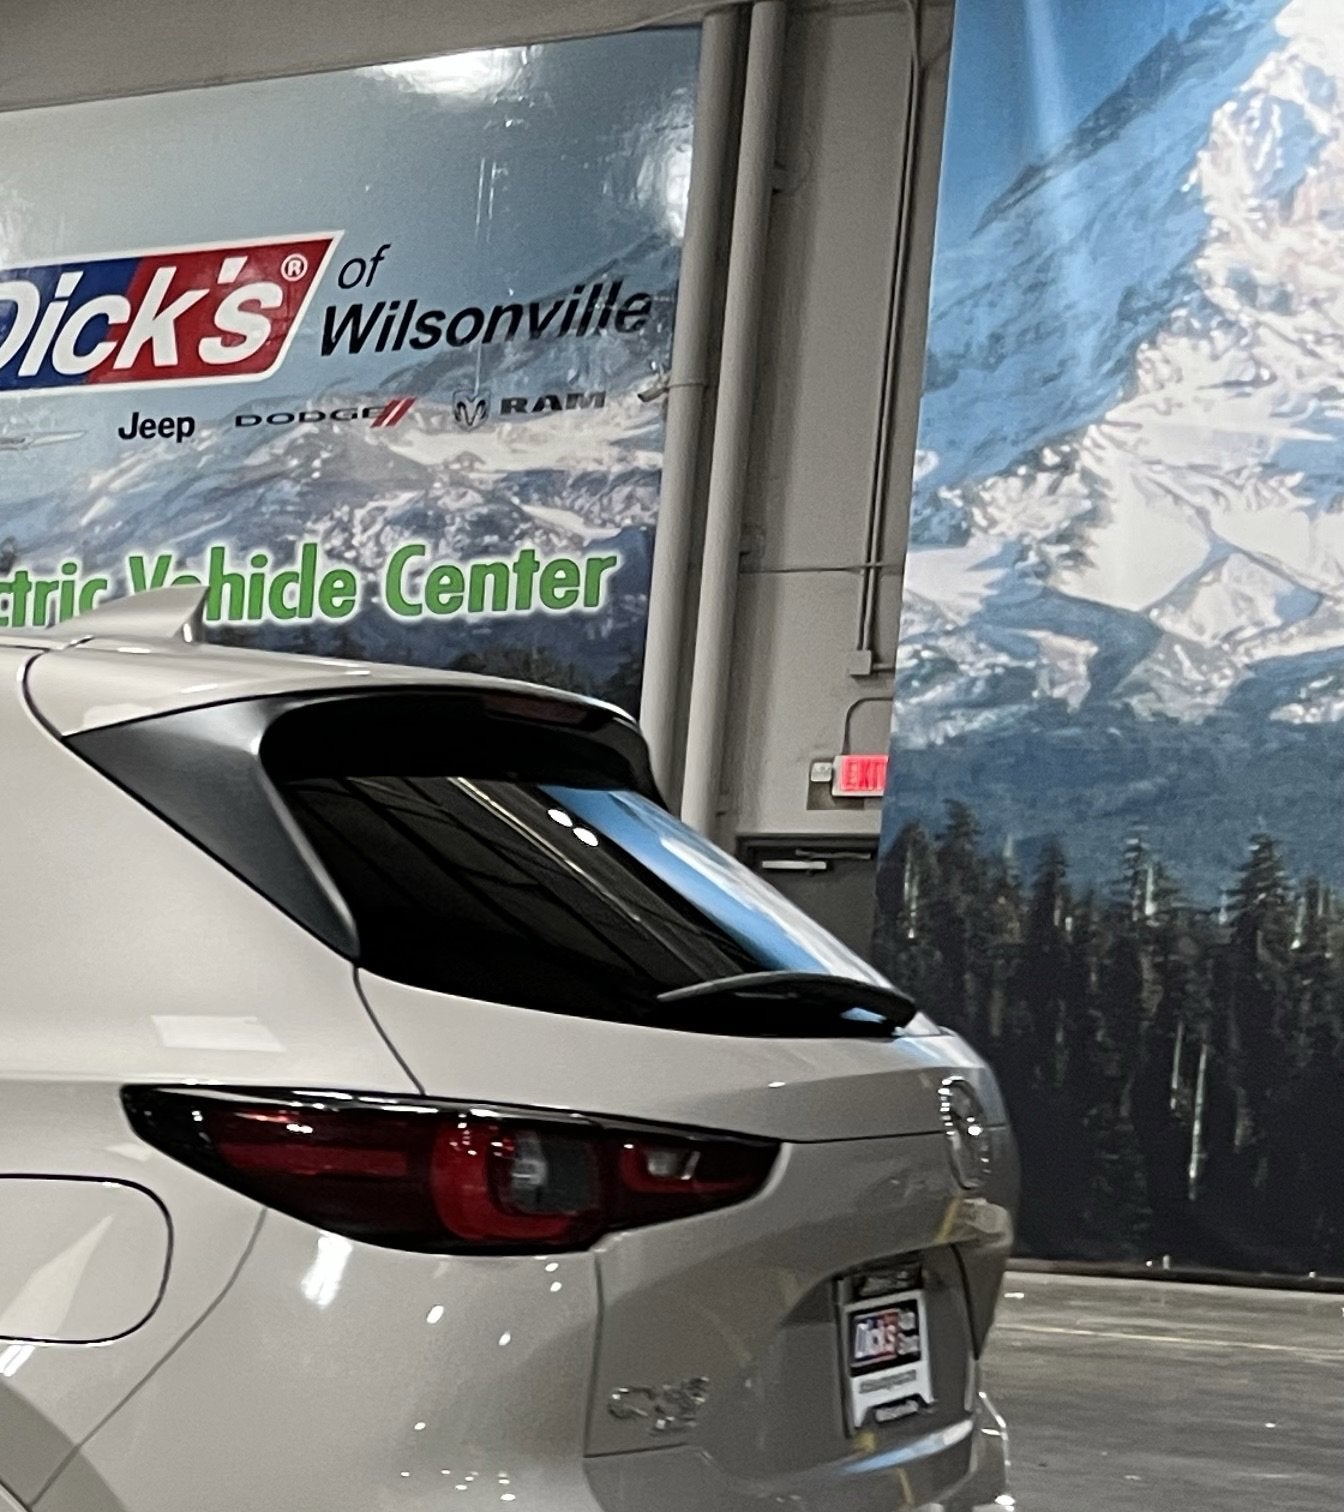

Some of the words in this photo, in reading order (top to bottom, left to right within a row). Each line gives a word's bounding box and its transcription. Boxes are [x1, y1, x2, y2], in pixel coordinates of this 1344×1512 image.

[337, 244, 391, 290] of
[321, 278, 652, 357] Wilsonville
[235, 407, 383, 428] DODGE
[499, 391, 606, 415] RAM
[117, 411, 196, 444] Jeep
[128, 543, 357, 621] Vhicle
[386, 545, 617, 616] Center
